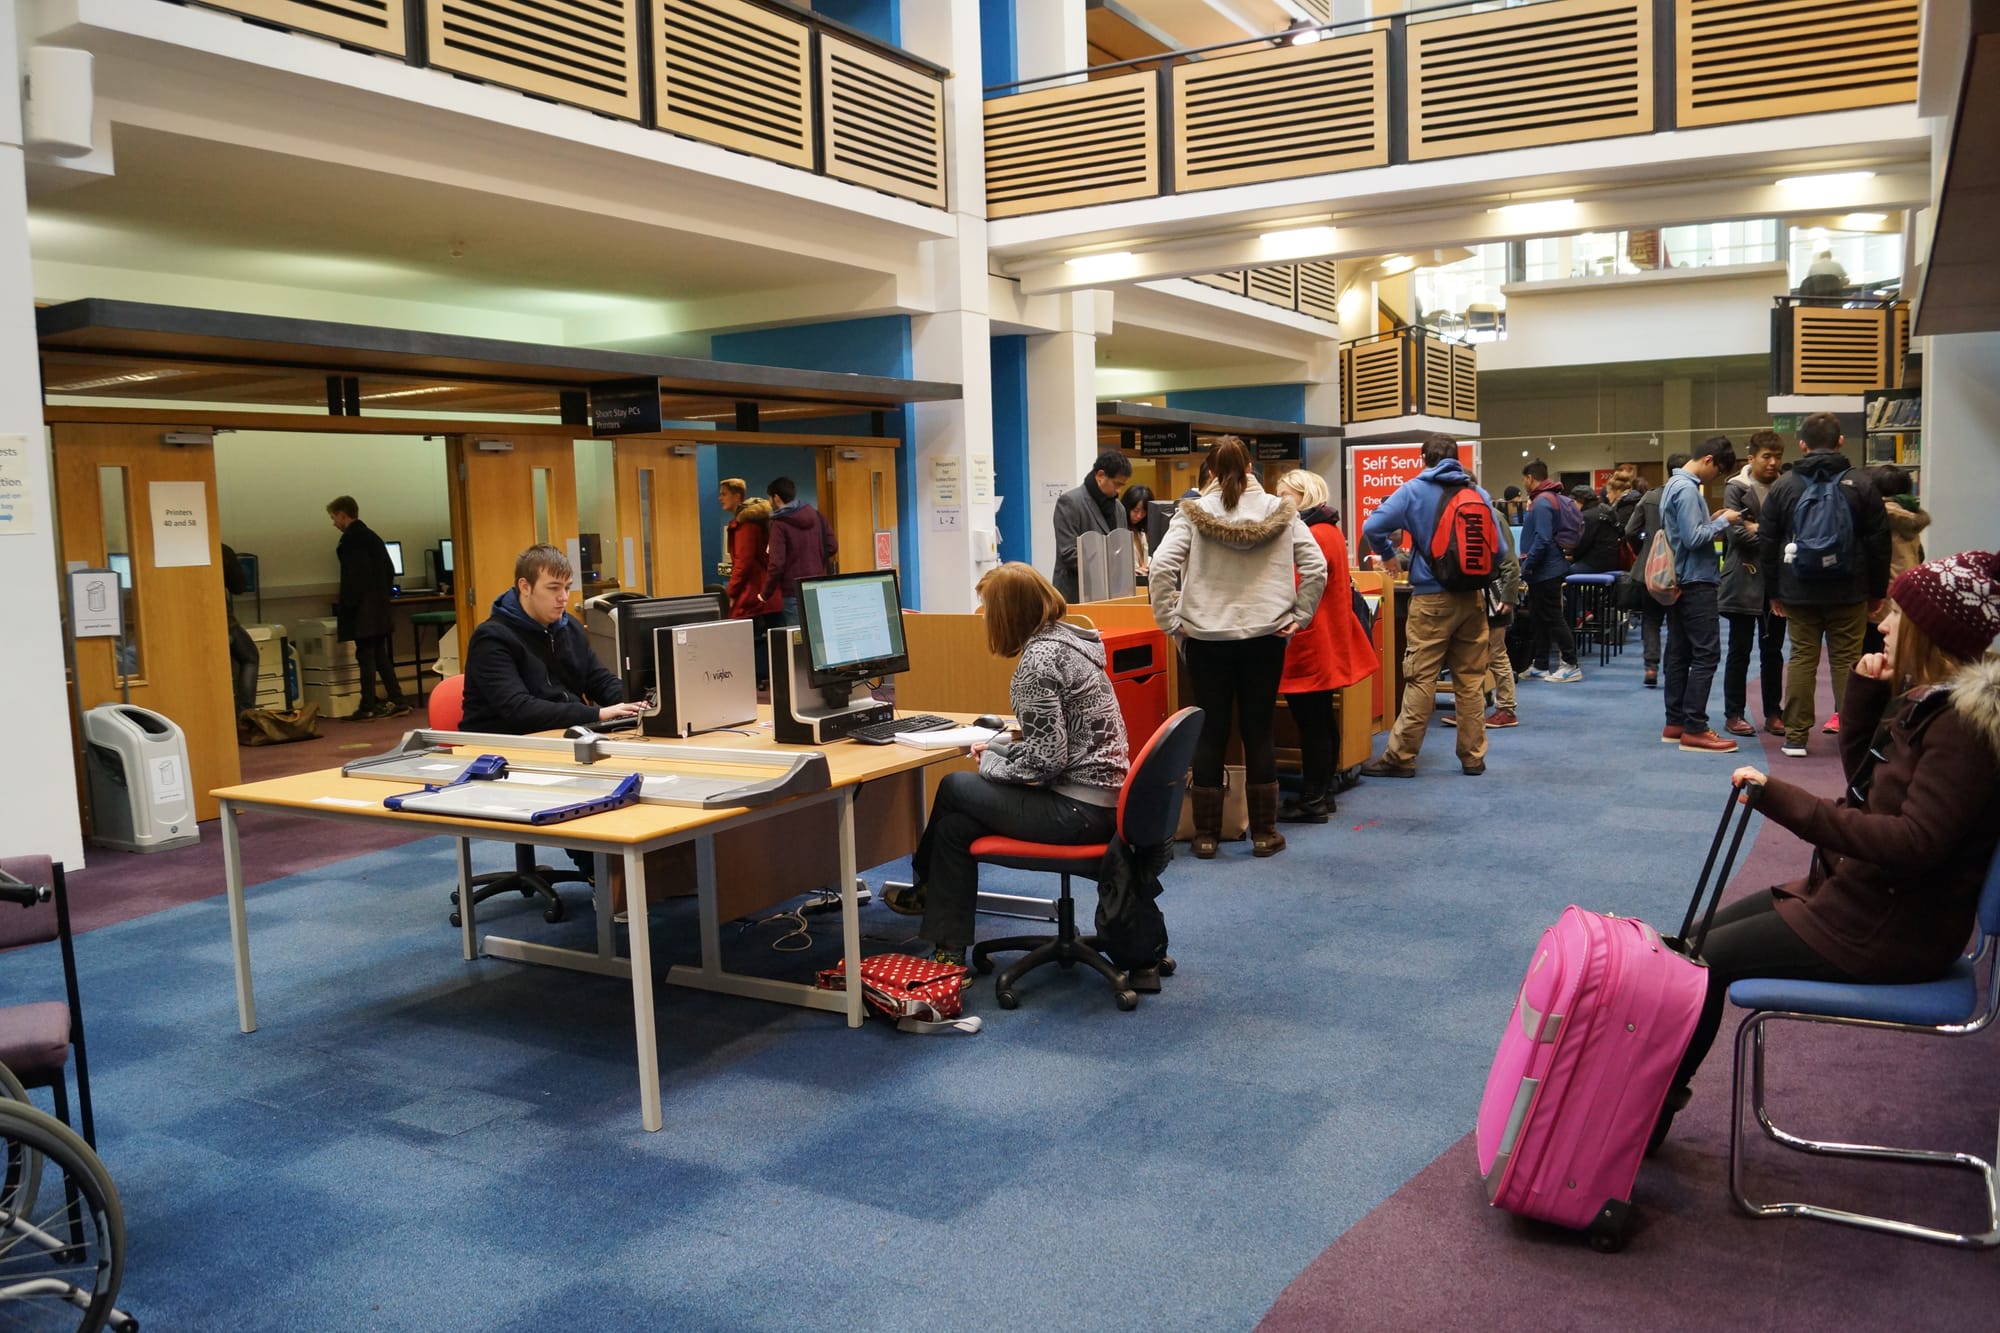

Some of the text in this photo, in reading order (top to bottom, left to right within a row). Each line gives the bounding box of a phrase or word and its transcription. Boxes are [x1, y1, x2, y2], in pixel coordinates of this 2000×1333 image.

[595, 407, 640, 418] Short Stay PCs
[0, 448, 18, 457] ests
[1362, 454, 1424, 471] Self Servi
[0, 477, 22, 487] tion
[1363, 473, 1404, 487] Points
[1363, 496, 1382, 505] Chec
[939, 516, 945, 525] L
[949, 516, 956, 525] Z
[1466, 514, 1482, 569] PUMA
